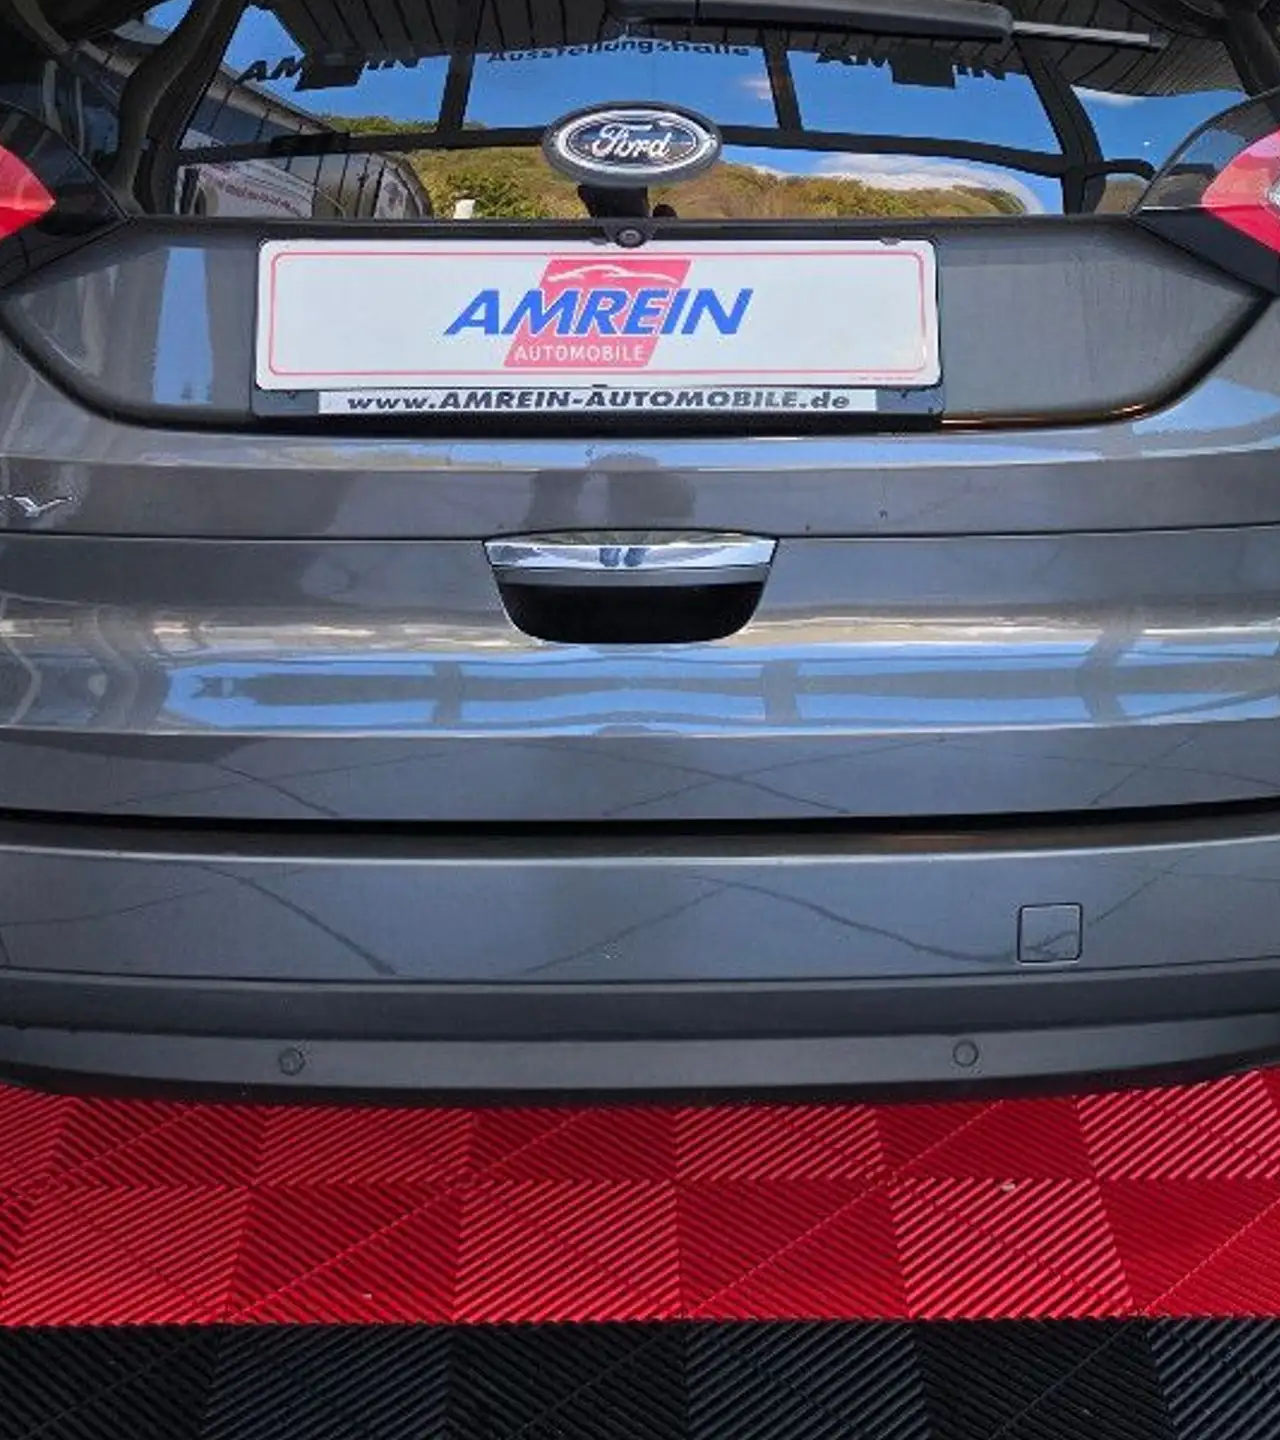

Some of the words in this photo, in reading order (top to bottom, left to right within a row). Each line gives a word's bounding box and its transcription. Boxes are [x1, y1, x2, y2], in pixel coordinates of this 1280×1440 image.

[591, 122, 672, 157] Ford
[442, 287, 754, 336] AMREIN
[514, 343, 646, 362] AUTOMOBILE
[347, 389, 851, 411] www.AMREIN-AUTOMOBILE.de
